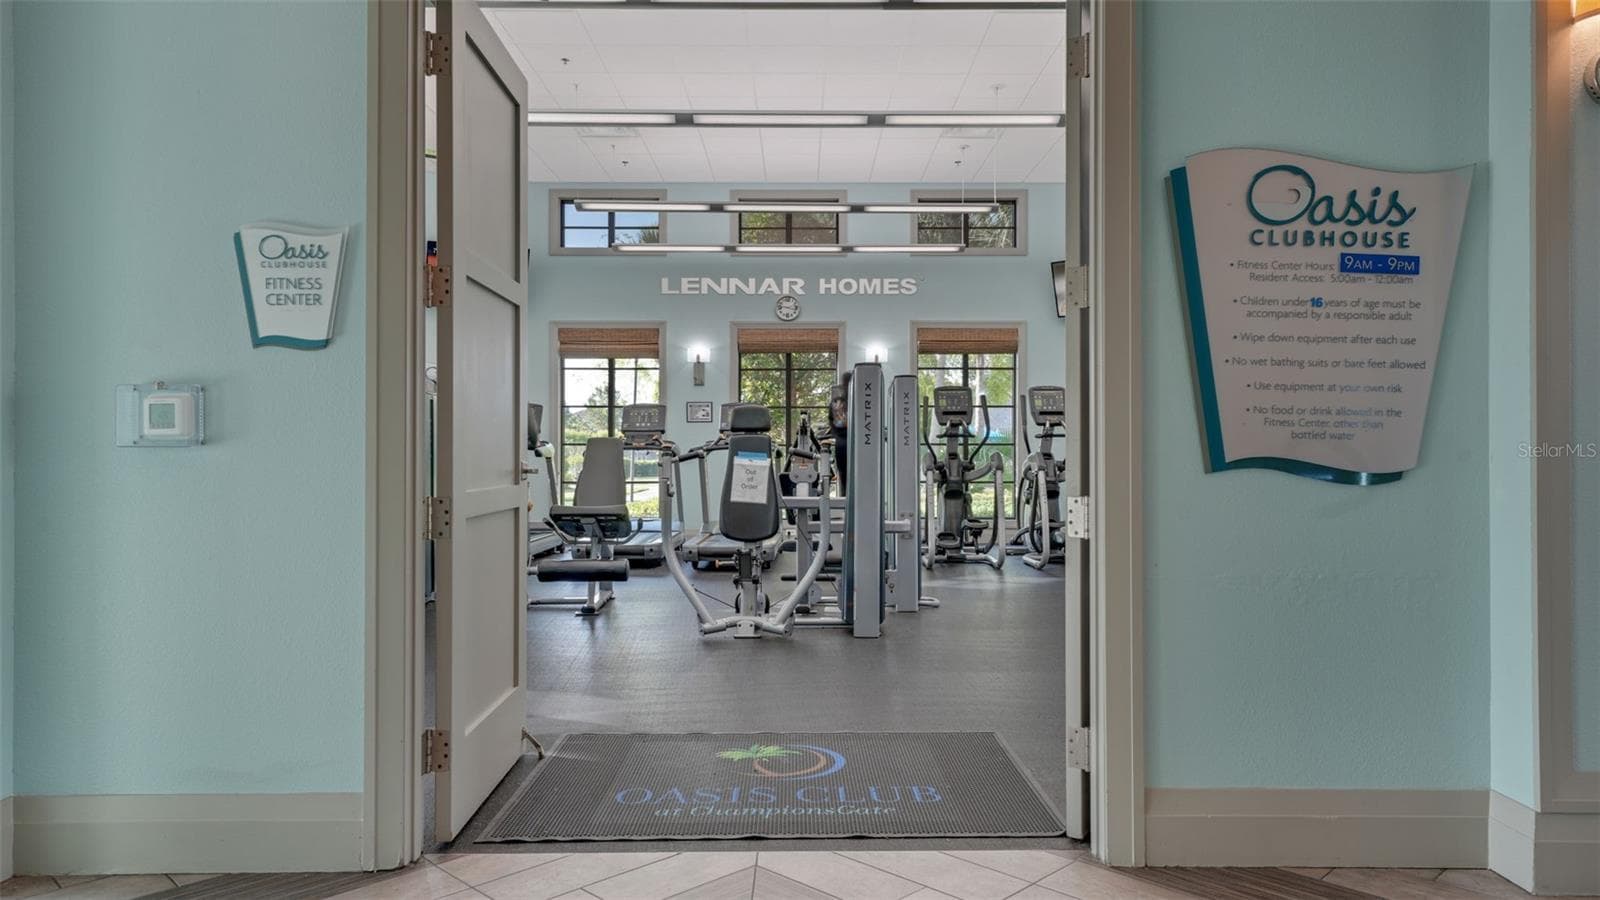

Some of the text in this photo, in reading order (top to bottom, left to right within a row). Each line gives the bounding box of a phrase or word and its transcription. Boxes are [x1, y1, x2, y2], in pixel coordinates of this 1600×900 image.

[1246, 164, 1417, 226] Oasis
[1250, 228, 1411, 249] CLUBHOUSE
[258, 234, 330, 260] Oasis
[260, 261, 327, 269] CLUBHOUSE
[1237, 260, 1268, 270] Fitness
[1271, 261, 1302, 271] Center
[1344, 255, 1373, 269] 9AM
[1387, 257, 1415, 271] 9PM
[265, 277, 323, 290] FITNESS
[1249, 272, 1289, 281] Resident
[661, 277, 918, 295] LENNAR HOMES
[265, 293, 323, 306] CENTER
[1240, 296, 1279, 306] Children
[1310, 297, 1323, 308] 16
[1350, 298, 1361, 308] of
[1363, 301, 1380, 311] age
[1382, 301, 1406, 309] must
[1408, 300, 1422, 309] be
[1246, 310, 1308, 320] accompanied
[1311, 310, 1322, 321] by
[1333, 311, 1386, 322] responsible
[1388, 312, 1412, 321] adult
[1240, 332, 1417, 346] Wipe down equipment after each use
[1231, 357, 1248, 366] No
[1249, 359, 1268, 367] wet
[1270, 356, 1305, 369] bathing
[1307, 359, 1329, 368] suits
[1344, 359, 1366, 369] bare
[1367, 358, 1387, 369] feet
[1389, 359, 1426, 370] allowed
[1253, 382, 1403, 395] Use equipment at your own risk
[864, 382, 872, 446] MATRIX
[1252, 404, 1403, 418] No food or drink allowed in the
[1263, 417, 1296, 428] Fitness
[1332, 420, 1360, 430] other
[1290, 431, 1356, 441] bottled water
[615, 785, 944, 804] OASIS CLUB
[655, 805, 898, 819] at ChampionsGate
